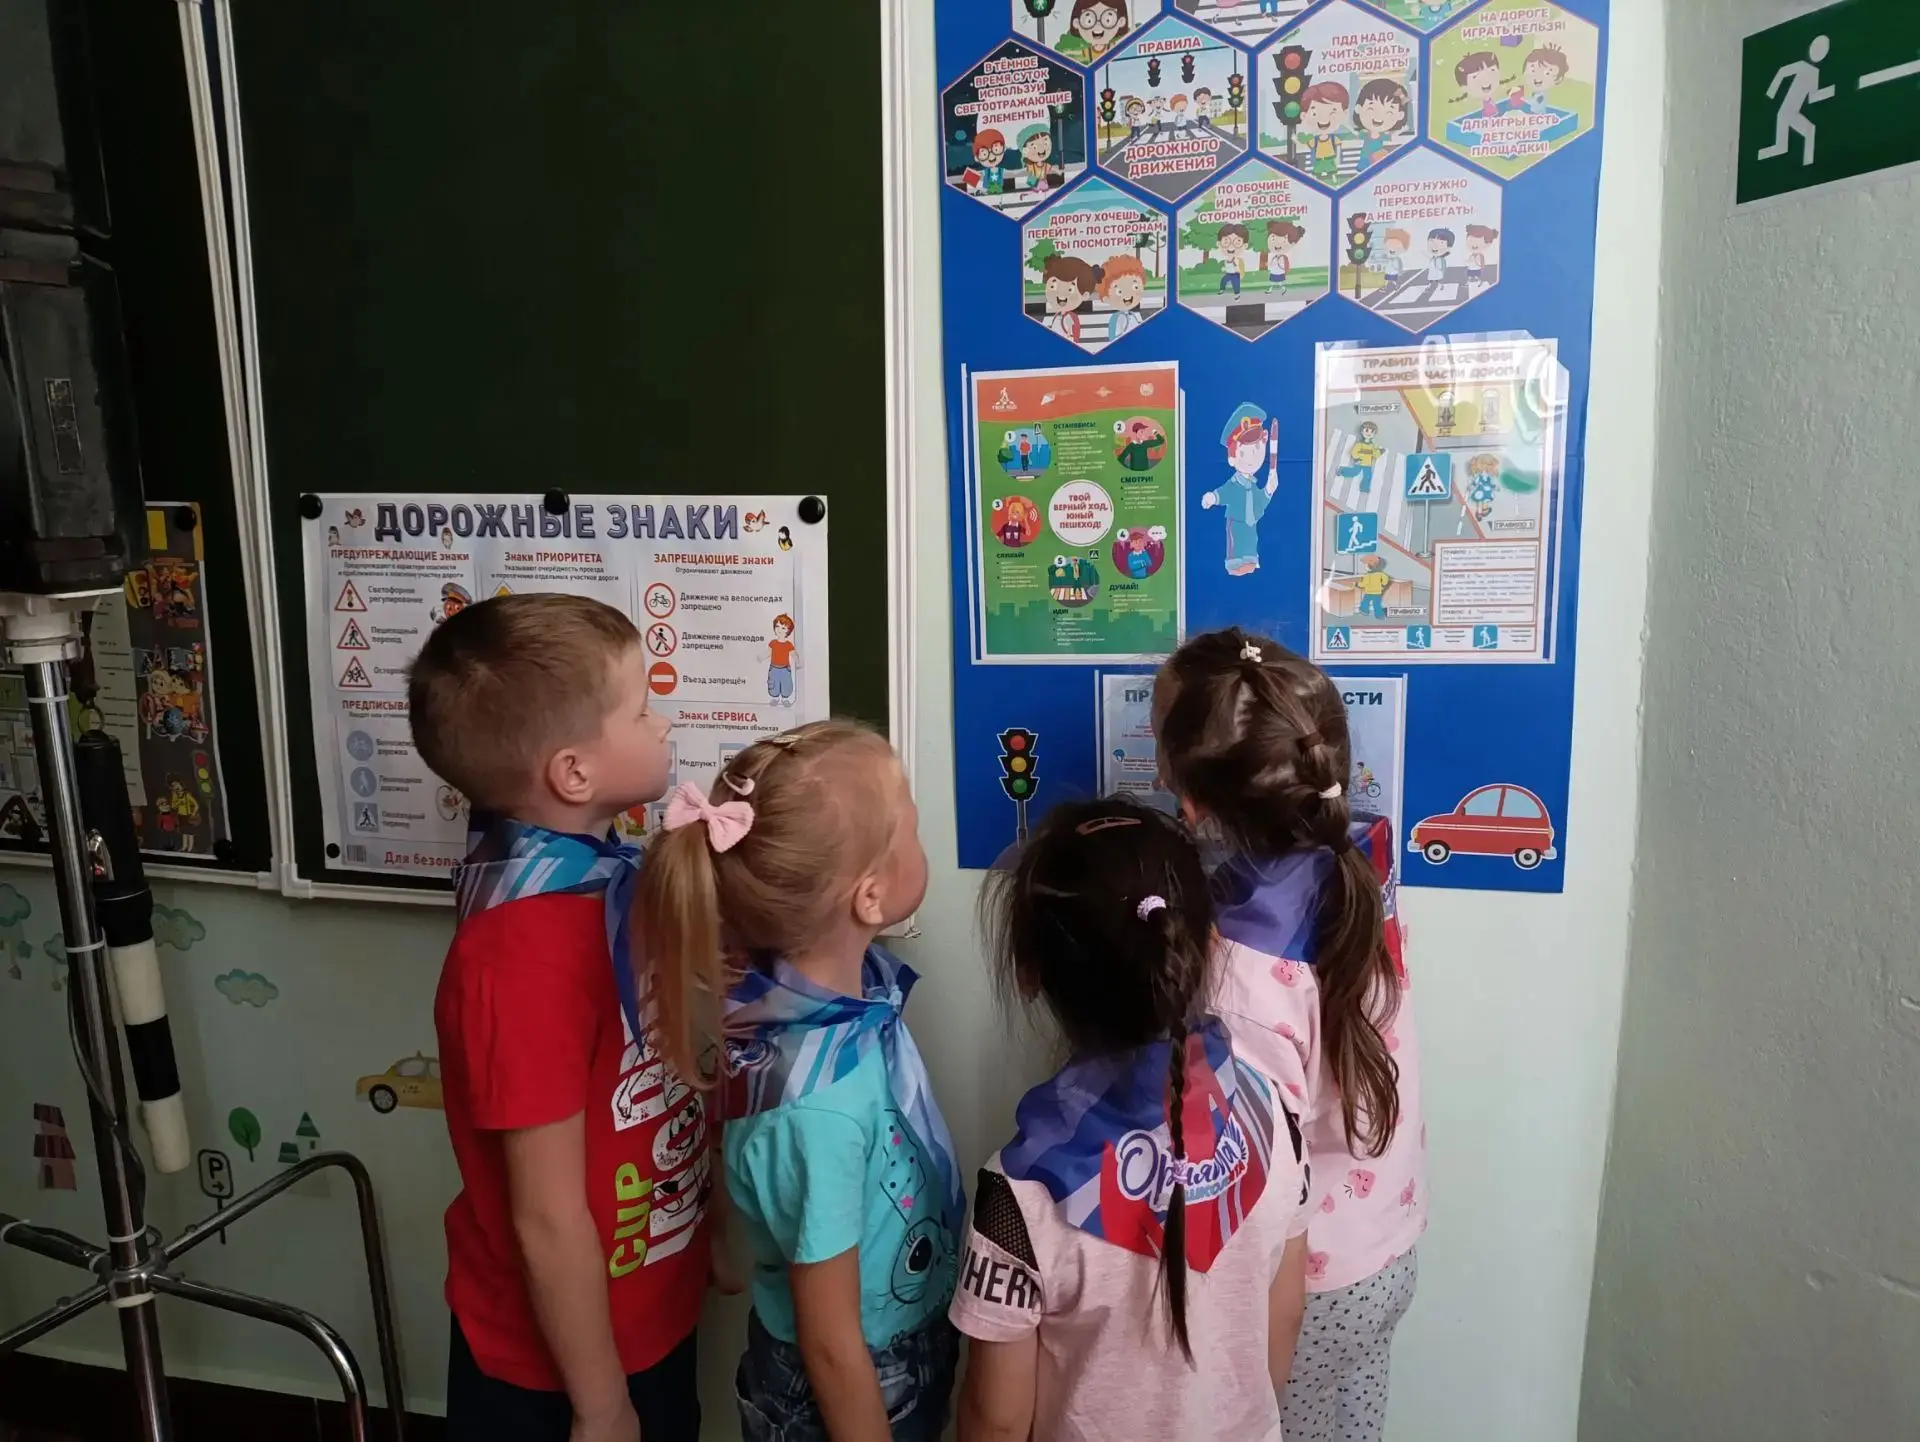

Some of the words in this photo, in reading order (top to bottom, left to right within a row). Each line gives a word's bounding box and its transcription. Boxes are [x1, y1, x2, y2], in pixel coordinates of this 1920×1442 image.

[1481, 12, 1497, 22] НА
[1500, 8, 1549, 21] ДОРОГЕ
[1463, 26, 1510, 37] ИГРАТЬ
[1513, 22, 1566, 34] НЕЛЬЗЯ!
[1138, 37, 1202, 54] ПРАВИЛА
[1332, 35, 1358, 46] ПДД
[1361, 32, 1394, 43] НАДО
[1321, 48, 1363, 60] УЧИТЬ,
[985, 63, 992, 73] В
[995, 57, 1037, 71] ТЁМНОЕ
[1318, 65, 1327, 74] И
[1329, 58, 1408, 74] СОБЛЮДАТЬ!
[975, 74, 1011, 86] ВРЕМЯ
[1013, 69, 1049, 81] СУТОК
[979, 81, 1045, 99] ИСПОЛЬЗУЙ
[956, 93, 1071, 115] СВЕТООТРАЖАЮЩИЕ
[982, 110, 1044, 124] ЭЛЕМЕНТЫ!
[1463, 119, 1488, 131] ДЛЯ
[1492, 117, 1526, 127] ИГРЫ
[1529, 115, 1560, 125] ЕСТЬ
[1482, 130, 1539, 143] ДЕТСКИЕ
[1126, 139, 1219, 161] ДОРОЖНОГО
[1472, 143, 1549, 156] ПЛОЩАДКИ!
[1130, 156, 1215, 178] ДВИЖЕНИЯ
[1217, 185, 1233, 194] ПО
[1236, 180, 1290, 193] ОБОЧИНЕ
[1373, 182, 1420, 196] ДОРОГУ
[1423, 178, 1468, 191] НУЖНО
[1216, 198, 1241, 209] ИДИ
[1251, 195, 1266, 205] ВО
[1269, 194, 1291, 204] ВСЕ
[1379, 193, 1461, 208] ПЕРЕХОДИТЬ,
[1050, 213, 1092, 226] ДОРОГУ
[1094, 211, 1139, 222] ХОЧЕШЬ
[1200, 210, 1255, 222] СТОРОНЫ
[1257, 205, 1308, 217] СМОТРИ!
[1366, 212, 1374, 221] А
[1377, 211, 1392, 220] НЕ
[1396, 206, 1474, 219] ПЕРЕБЕГАТЬ!
[1028, 226, 1077, 238] ПЕРЕЙТИ
[1086, 226, 1101, 236] ПО
[1103, 222, 1162, 234] СТОРОНАМ
[1055, 240, 1070, 249] ТЫ
[1073, 237, 1135, 248] ПОСМОТРИ!
[1363, 357, 1419, 369] ПРАВИЛА
[1068, 492, 1091, 501] ТВОЙ
[1053, 502, 1086, 511] ВЕРНЫЙ
[374, 502, 596, 543] ДОРОЖНЫЕ
[606, 504, 739, 540] ЗНАКИ
[1066, 511, 1094, 520] ЮНЫЙ
[1059, 521, 1102, 529] ПЕШЕХОД!
[331, 549, 437, 561] ПРЕДУПРЕЖДАЮЩИЕ
[440, 553, 470, 561] знаки
[504, 552, 534, 561] Знаки
[536, 553, 602, 563] ПРИОРИТЕТА
[654, 553, 739, 566] ЗАПРЕЩАЮЩИЕ
[742, 557, 774, 565] знаки
[680, 593, 719, 602] Движение
[731, 595, 783, 603] велосипедах
[680, 603, 722, 611] запрещено
[682, 632, 721, 641] Движение
[682, 675, 707, 684] Въезд
[708, 677, 746, 686] запрещён
[342, 700, 410, 710] ПРЕДПИСЫВА
[678, 711, 708, 720] Знаки
[711, 712, 758, 722] СЕРВИСА
[680, 759, 717, 768] Медпункт
[385, 851, 410, 864] Для
[414, 853, 458, 867] безопа
[208, 1155, 224, 1181] P
[608, 1161, 653, 1279] CUP
